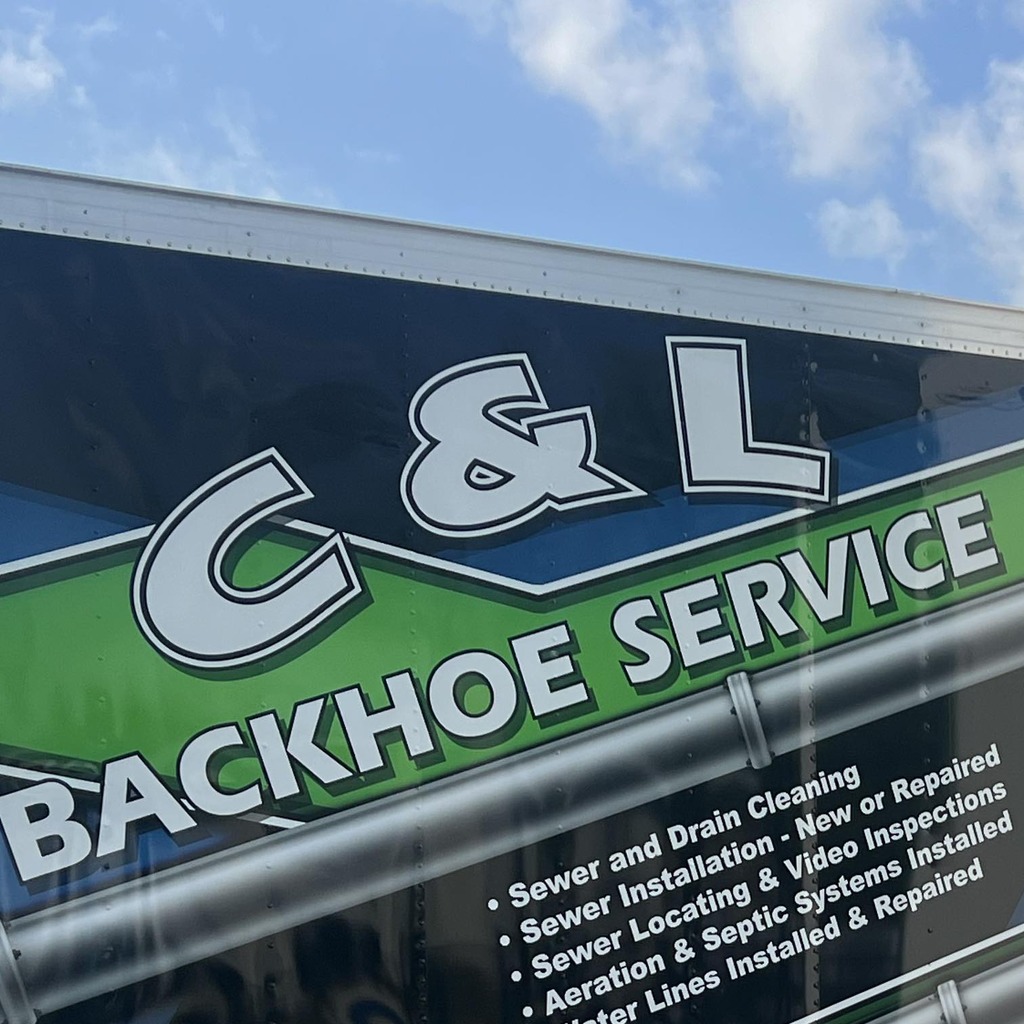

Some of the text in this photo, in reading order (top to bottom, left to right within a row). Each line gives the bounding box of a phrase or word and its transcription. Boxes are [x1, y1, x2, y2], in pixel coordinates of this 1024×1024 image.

[131, 335, 830, 669] C & L
[0, 493, 1000, 883] BACKHOE SERVICE
[508, 764, 862, 909] Sewer and Drain Cleaning
[520, 743, 1002, 944] Sewer Installation - New or Repaired
[531, 781, 1007, 980] Sewer Locating & Video Inspections
[545, 809, 1014, 1017] Aeration & Septic Systems Installed
[644, 969, 721, 1014] Lines
[726, 915, 842, 981] Installed
[848, 905, 869, 931] &
[873, 856, 984, 920] Repaired
